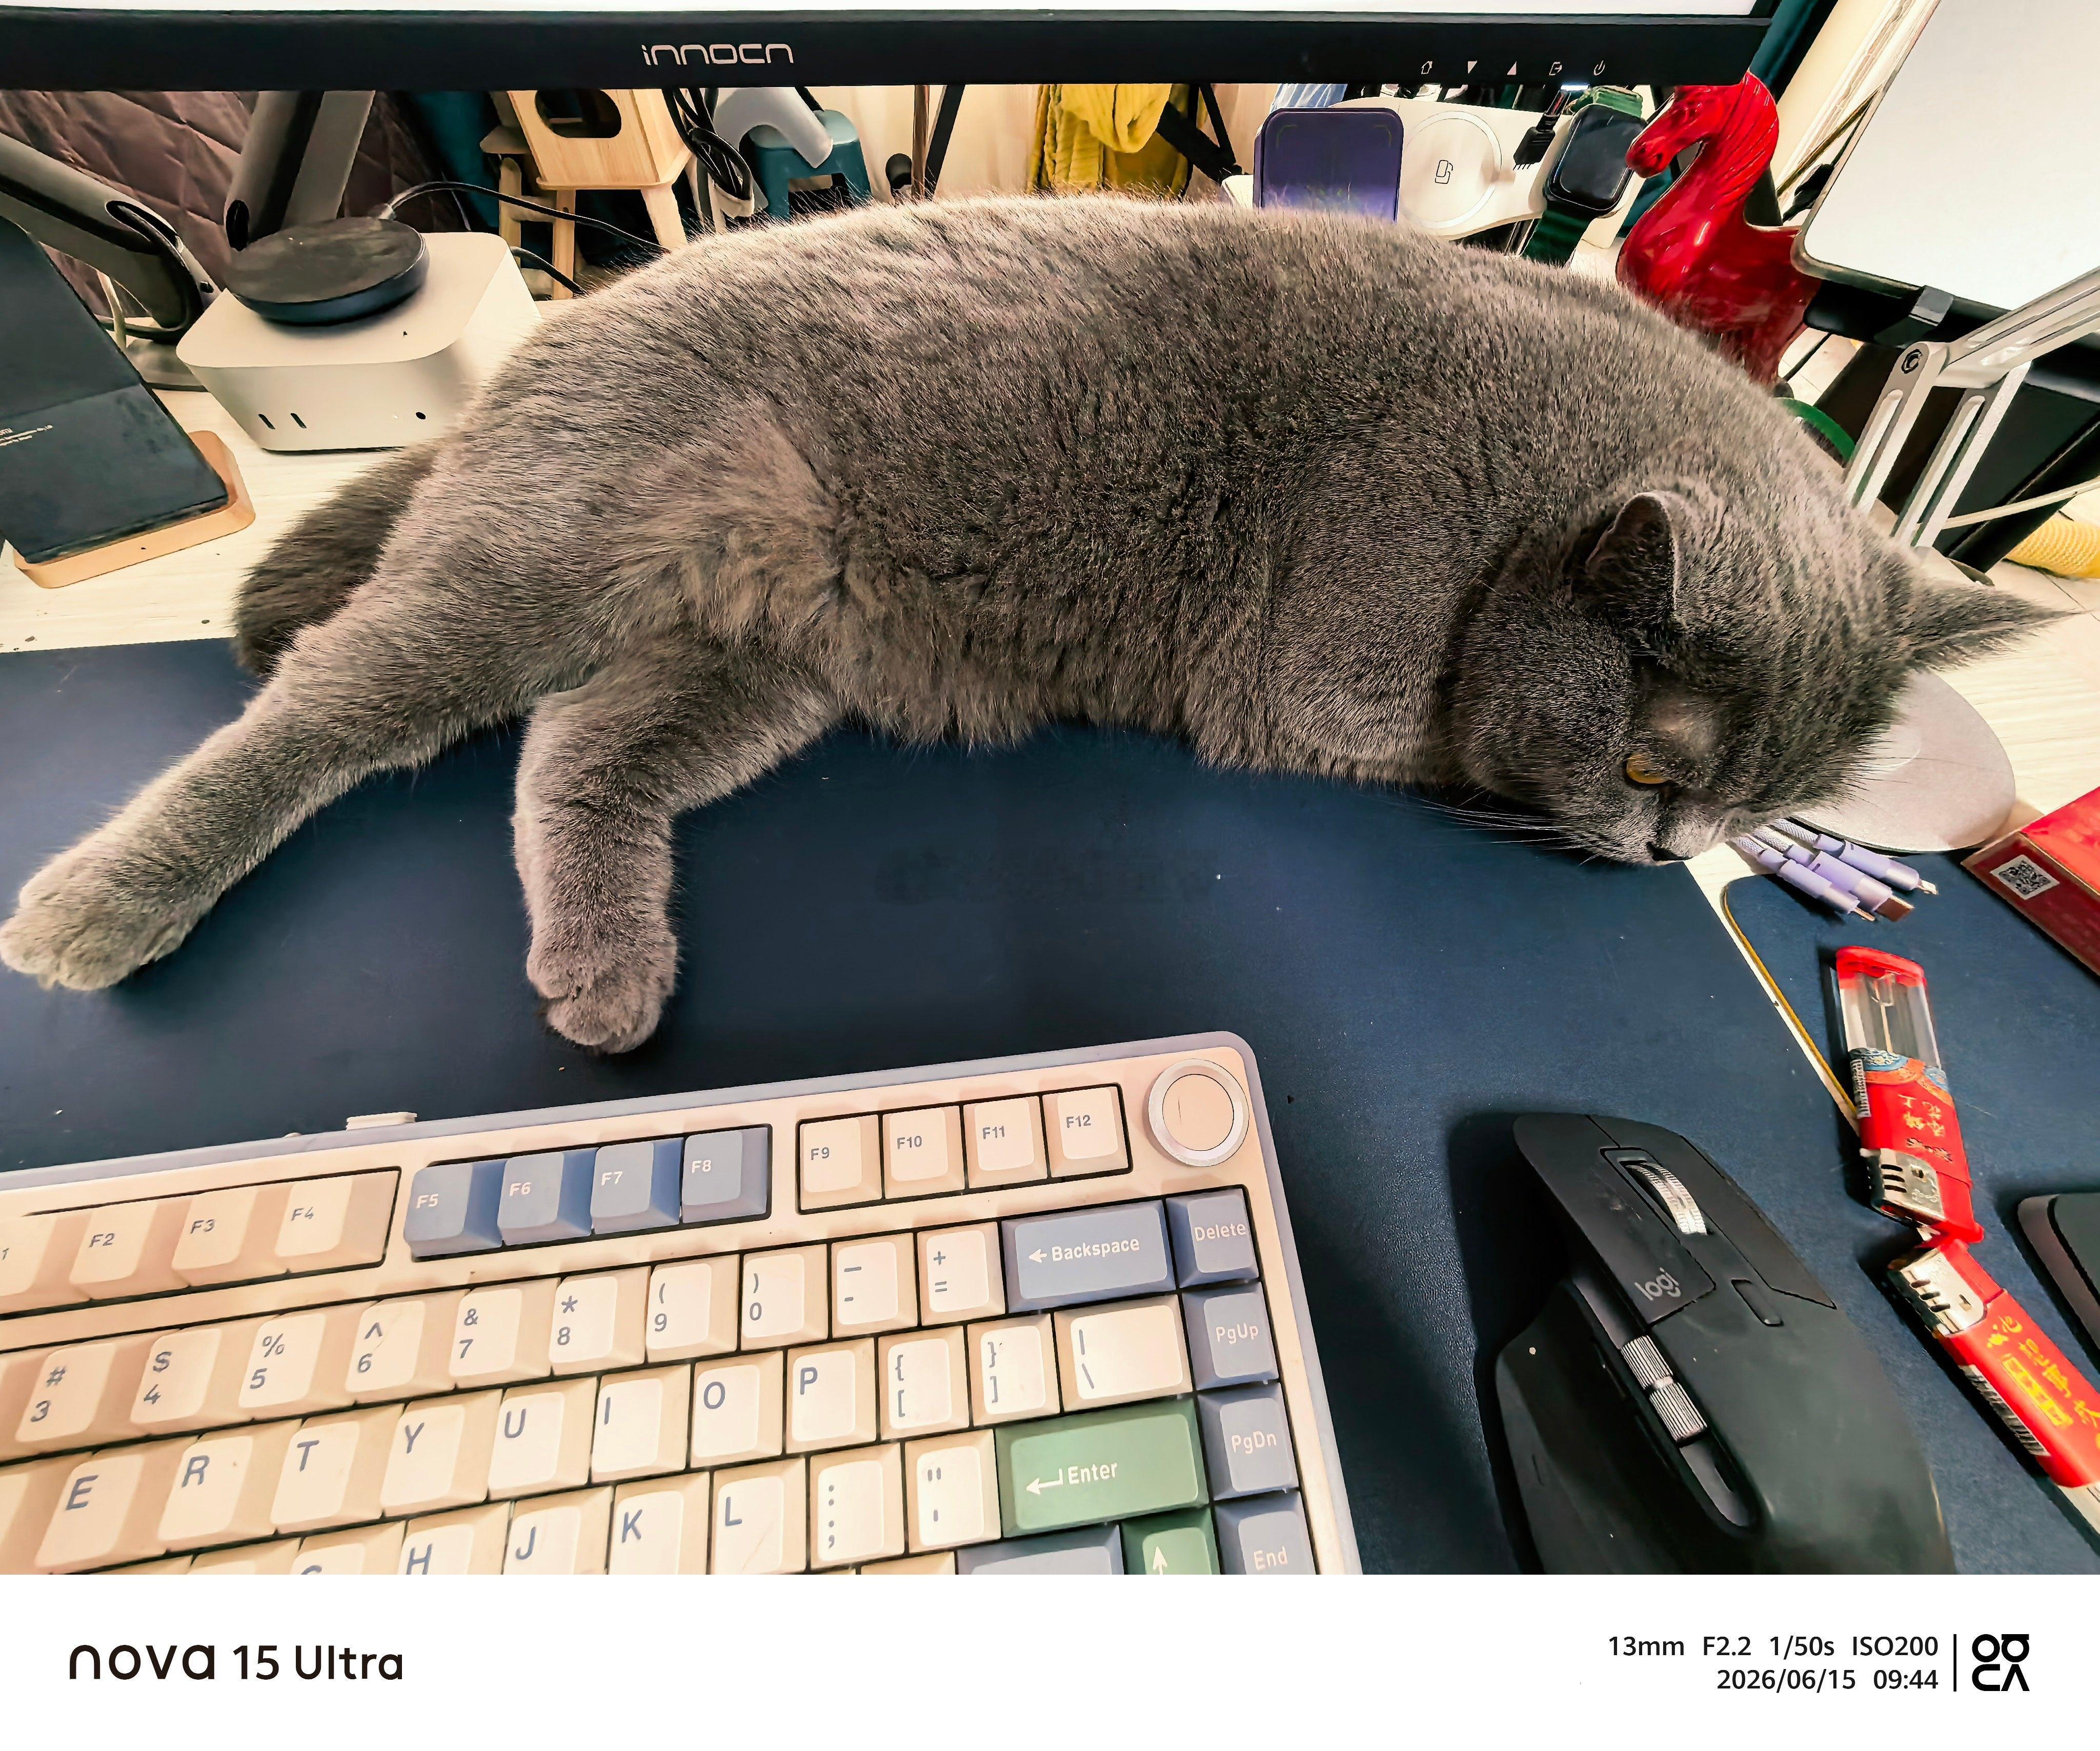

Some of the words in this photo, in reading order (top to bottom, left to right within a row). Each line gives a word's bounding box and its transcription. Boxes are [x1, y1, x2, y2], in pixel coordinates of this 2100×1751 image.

[982, 1125, 1005, 1140] F11
[1066, 1114, 1092, 1129] F12
[811, 1147, 830, 1160] F9
[897, 1135, 922, 1150] F10
[691, 1159, 712, 1174] F8
[509, 1182, 532, 1196] F6
[601, 1171, 623, 1186] F7
[416, 1193, 439, 1209] F5
[291, 1207, 314, 1221] F4
[190, 1219, 215, 1234] F3
[1194, 1221, 1246, 1242] Delete
[89, 1233, 115, 1248] F2
[1052, 1238, 1140, 1261] Backspace
[1634, 1267, 1681, 1301] logi
[654, 1313, 668, 1332] 9
[749, 1302, 762, 1321] 0
[557, 1326, 571, 1346] 8
[1216, 1322, 1259, 1345] PgUp
[459, 1338, 474, 1359] 7
[357, 1353, 373, 1373] 6
[249, 1368, 268, 1390] 5
[799, 1367, 818, 1395] P
[143, 1383, 161, 1405] 4
[703, 1381, 725, 1410] O
[30, 1400, 50, 1422] 3
[604, 1397, 611, 1425] I
[504, 1409, 527, 1438] U
[405, 1422, 425, 1454] Y
[1231, 1431, 1277, 1454] PgDn
[296, 1440, 320, 1472] T
[181, 1455, 210, 1488] R
[1067, 1462, 1117, 1485] Enter
[65, 1475, 99, 1511] E
[724, 1496, 742, 1527] L
[621, 1509, 643, 1543] K
[515, 1526, 536, 1560] J
[406, 1543, 432, 1575] H
[1253, 1545, 1288, 1571] End
